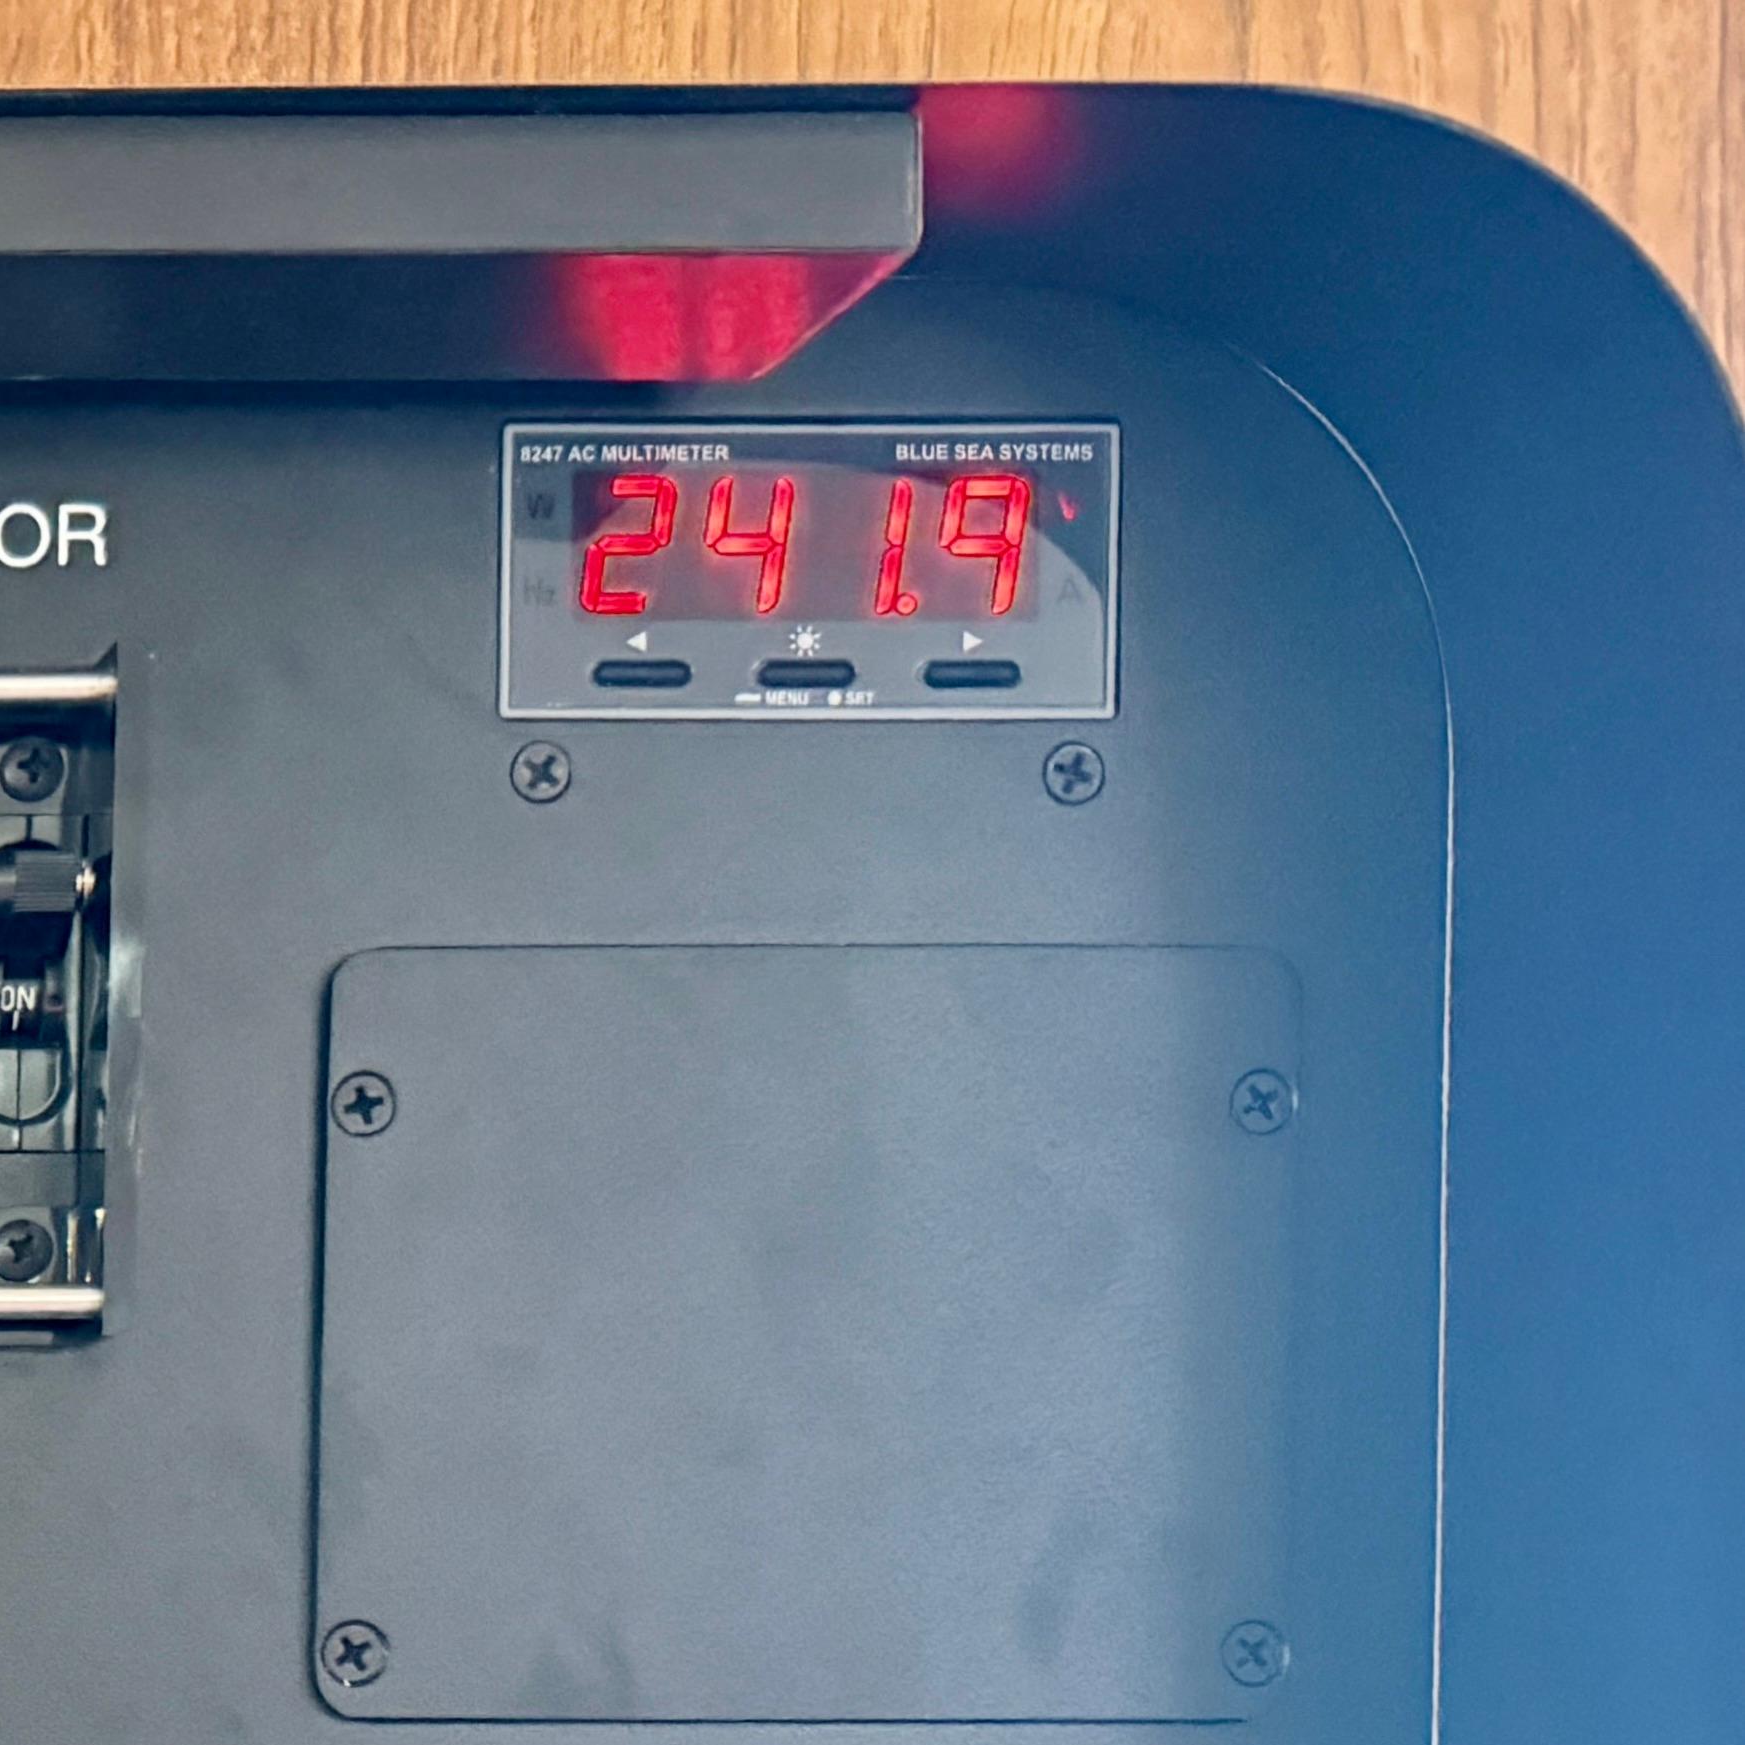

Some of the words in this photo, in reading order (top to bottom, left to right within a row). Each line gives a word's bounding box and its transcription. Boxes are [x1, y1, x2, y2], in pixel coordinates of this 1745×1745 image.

[520, 445, 564, 463] 8247
[567, 444, 596, 463] AC
[601, 444, 730, 464] MULTIMETER
[895, 443, 949, 461] BLUE
[954, 443, 994, 461] SEA
[999, 443, 1093, 461] SYSTEMS
[765, 690, 809, 705] MENU
[845, 691, 874, 705] SET
